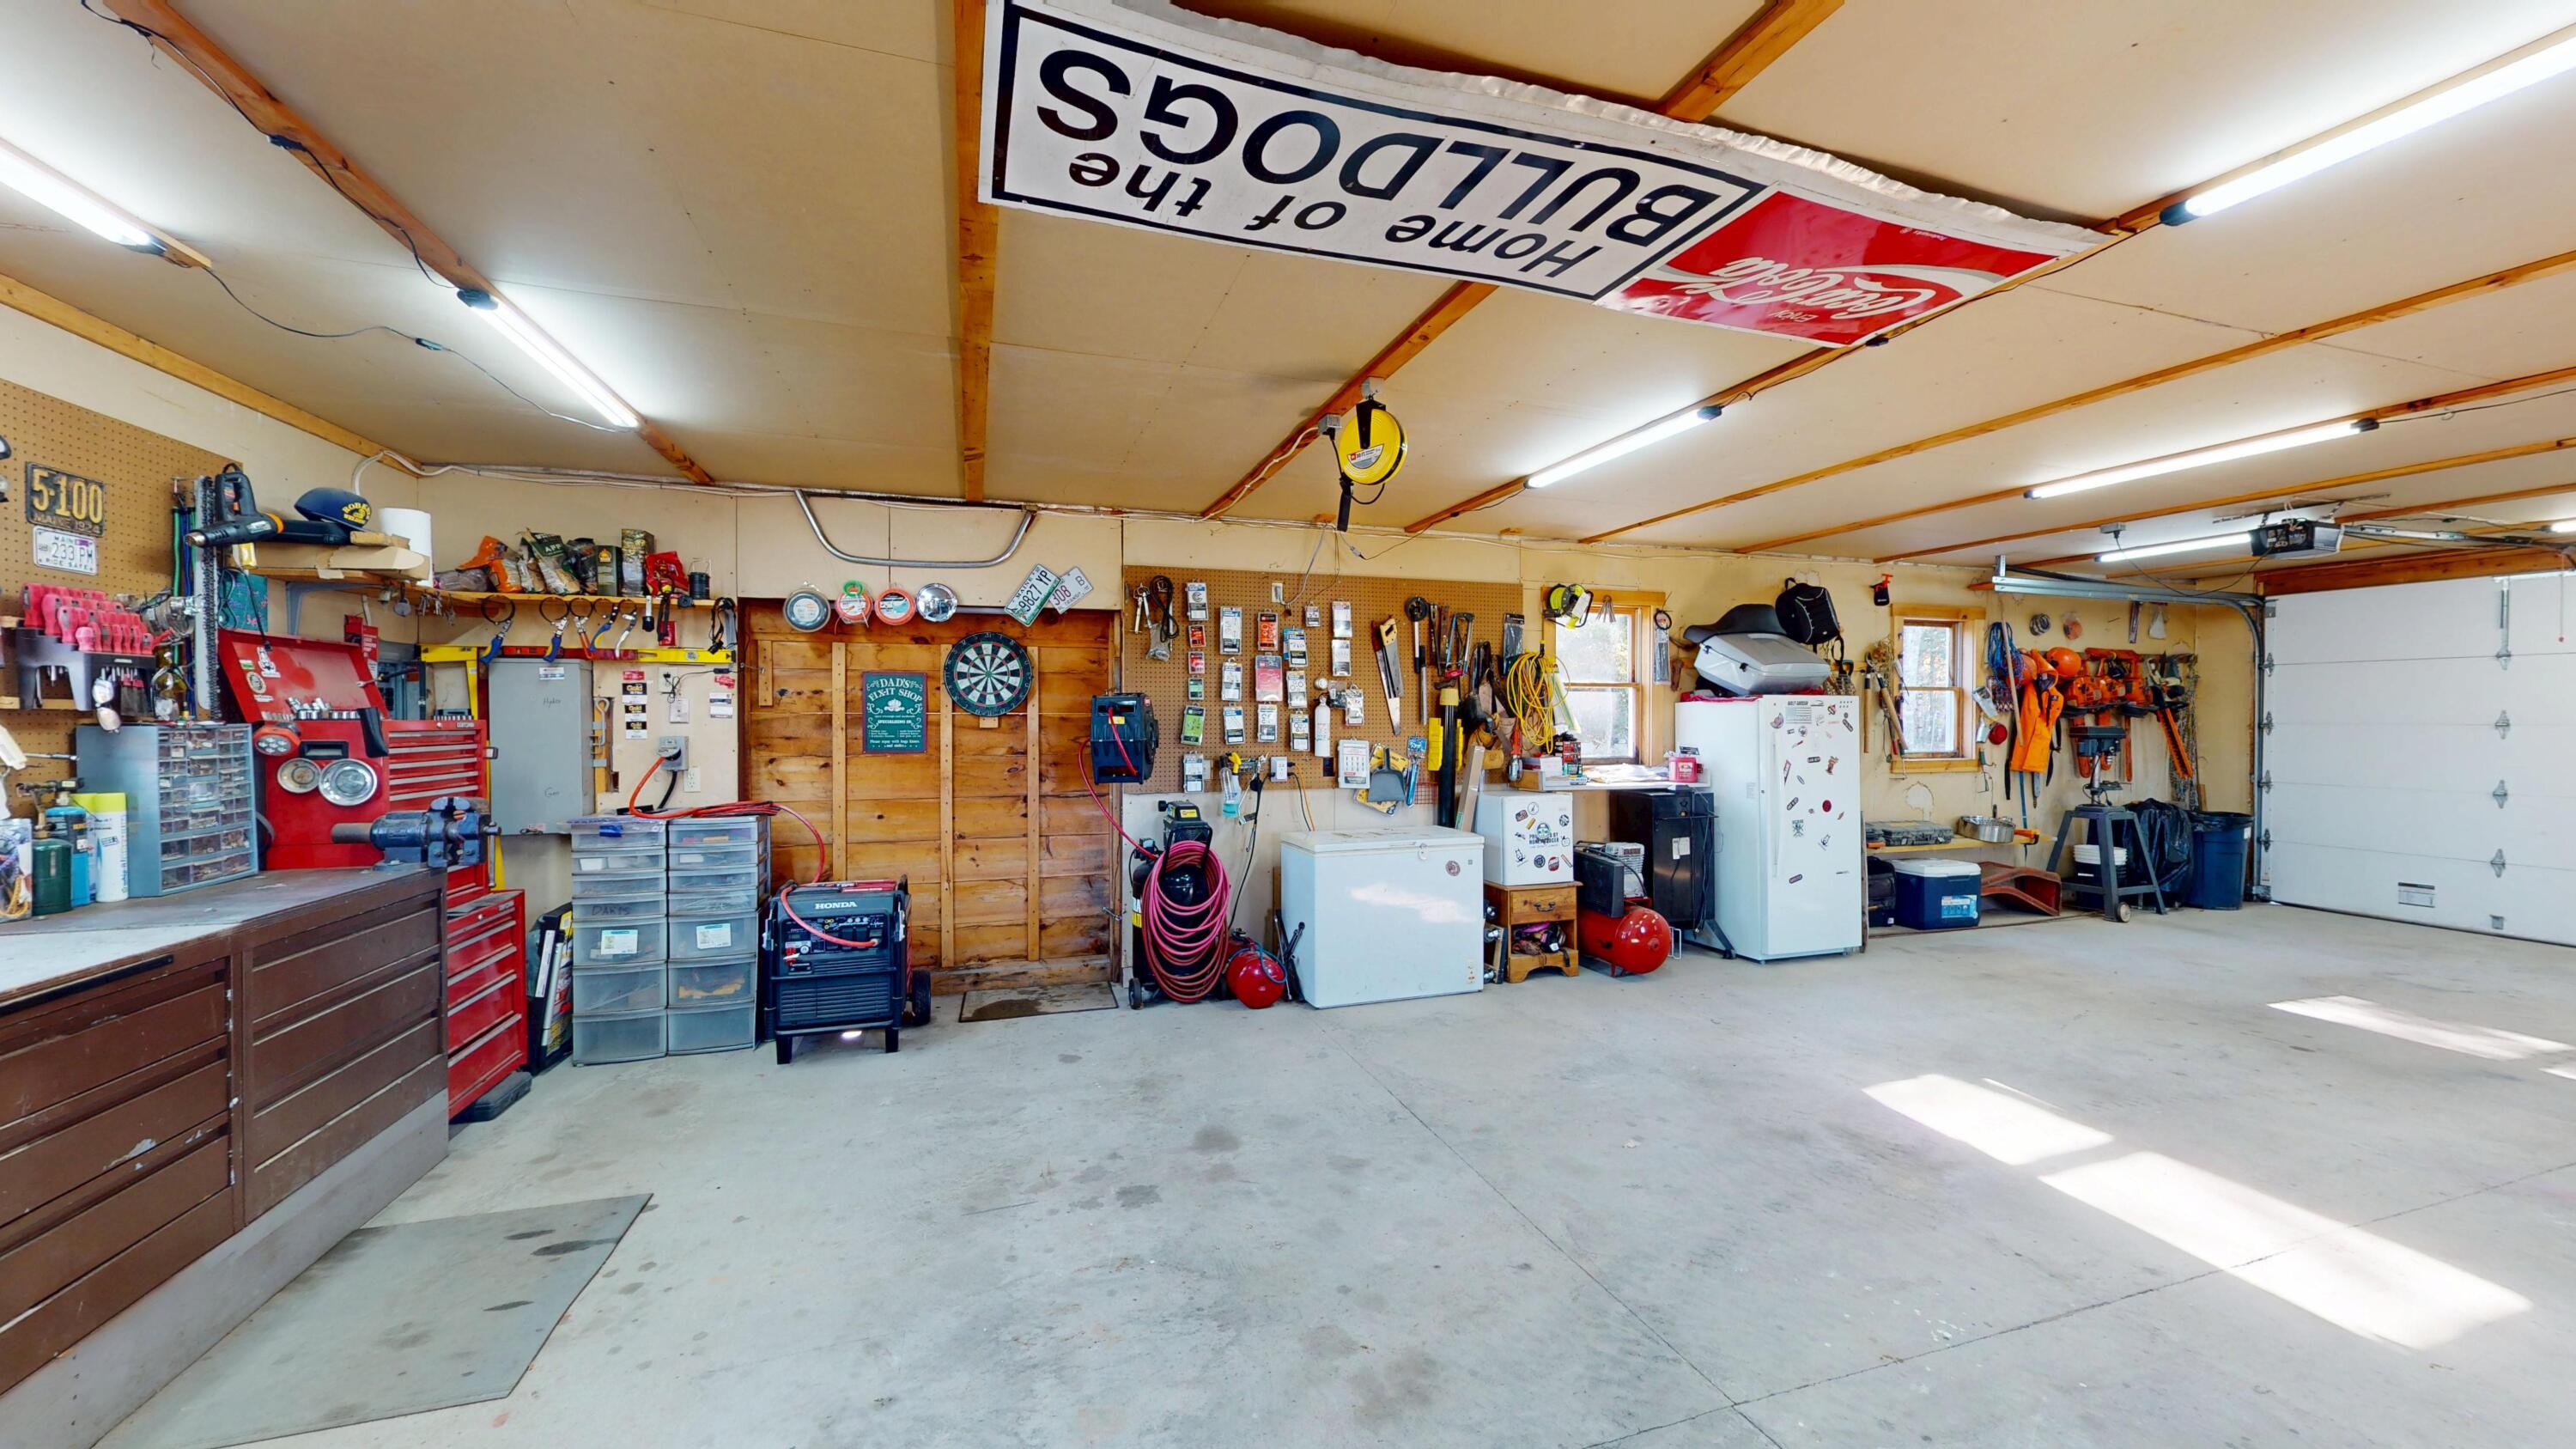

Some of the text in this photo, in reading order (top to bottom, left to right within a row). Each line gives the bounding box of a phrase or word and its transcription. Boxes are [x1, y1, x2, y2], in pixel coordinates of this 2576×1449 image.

[1036, 49, 1722, 247] BULLDOGS
[1069, 153, 1604, 278] Home of the
[1771, 310, 1820, 323] Enjoy
[52, 542, 76, 561] 233
[1016, 577, 1033, 600] MAINE
[1018, 569, 1052, 612] 9827 YP
[1052, 575, 1085, 606] 308 B
[879, 678, 911, 689] DAD'S
[868, 687, 922, 703] FIX-IT SHOP
[815, 901, 858, 910] HONDA
